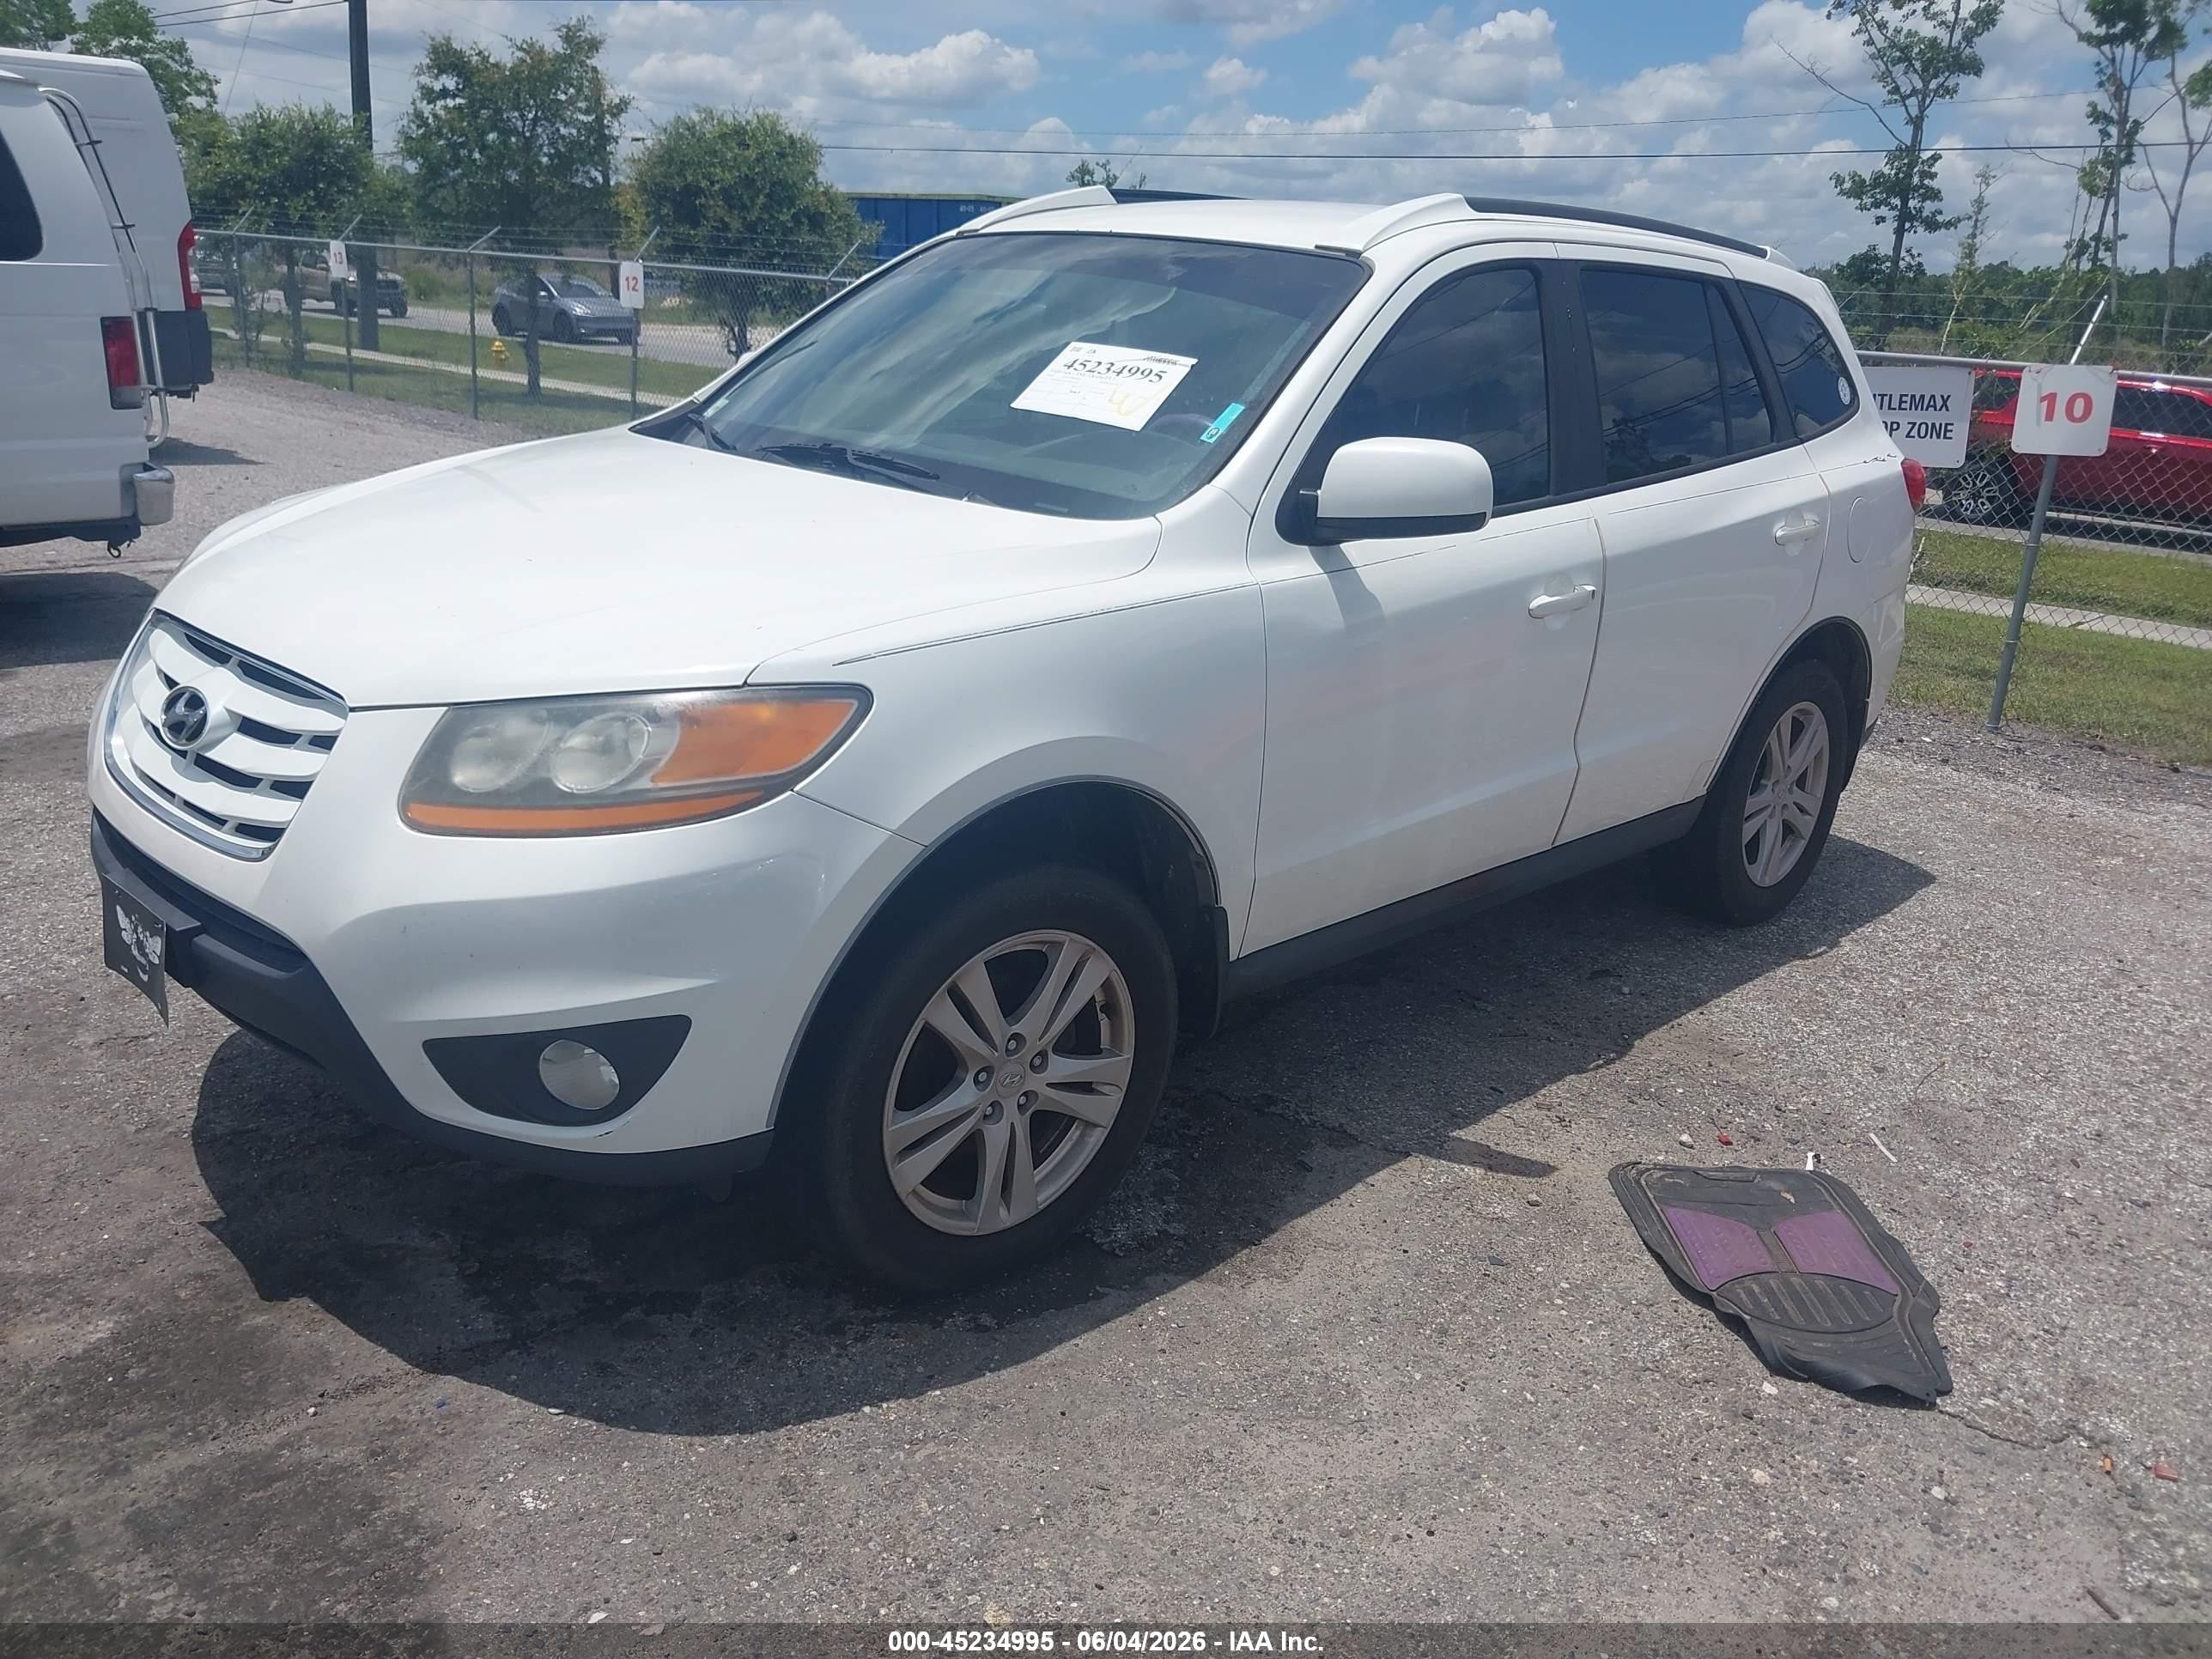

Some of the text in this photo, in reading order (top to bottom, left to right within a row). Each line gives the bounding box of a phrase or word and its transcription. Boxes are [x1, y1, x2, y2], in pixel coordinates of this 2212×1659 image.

[333, 251, 343, 264] 13
[625, 276, 639, 292] 12
[1063, 358, 1168, 384] 45234995
[2039, 392, 2094, 423] 10
[1905, 422, 1954, 440] ZONE
